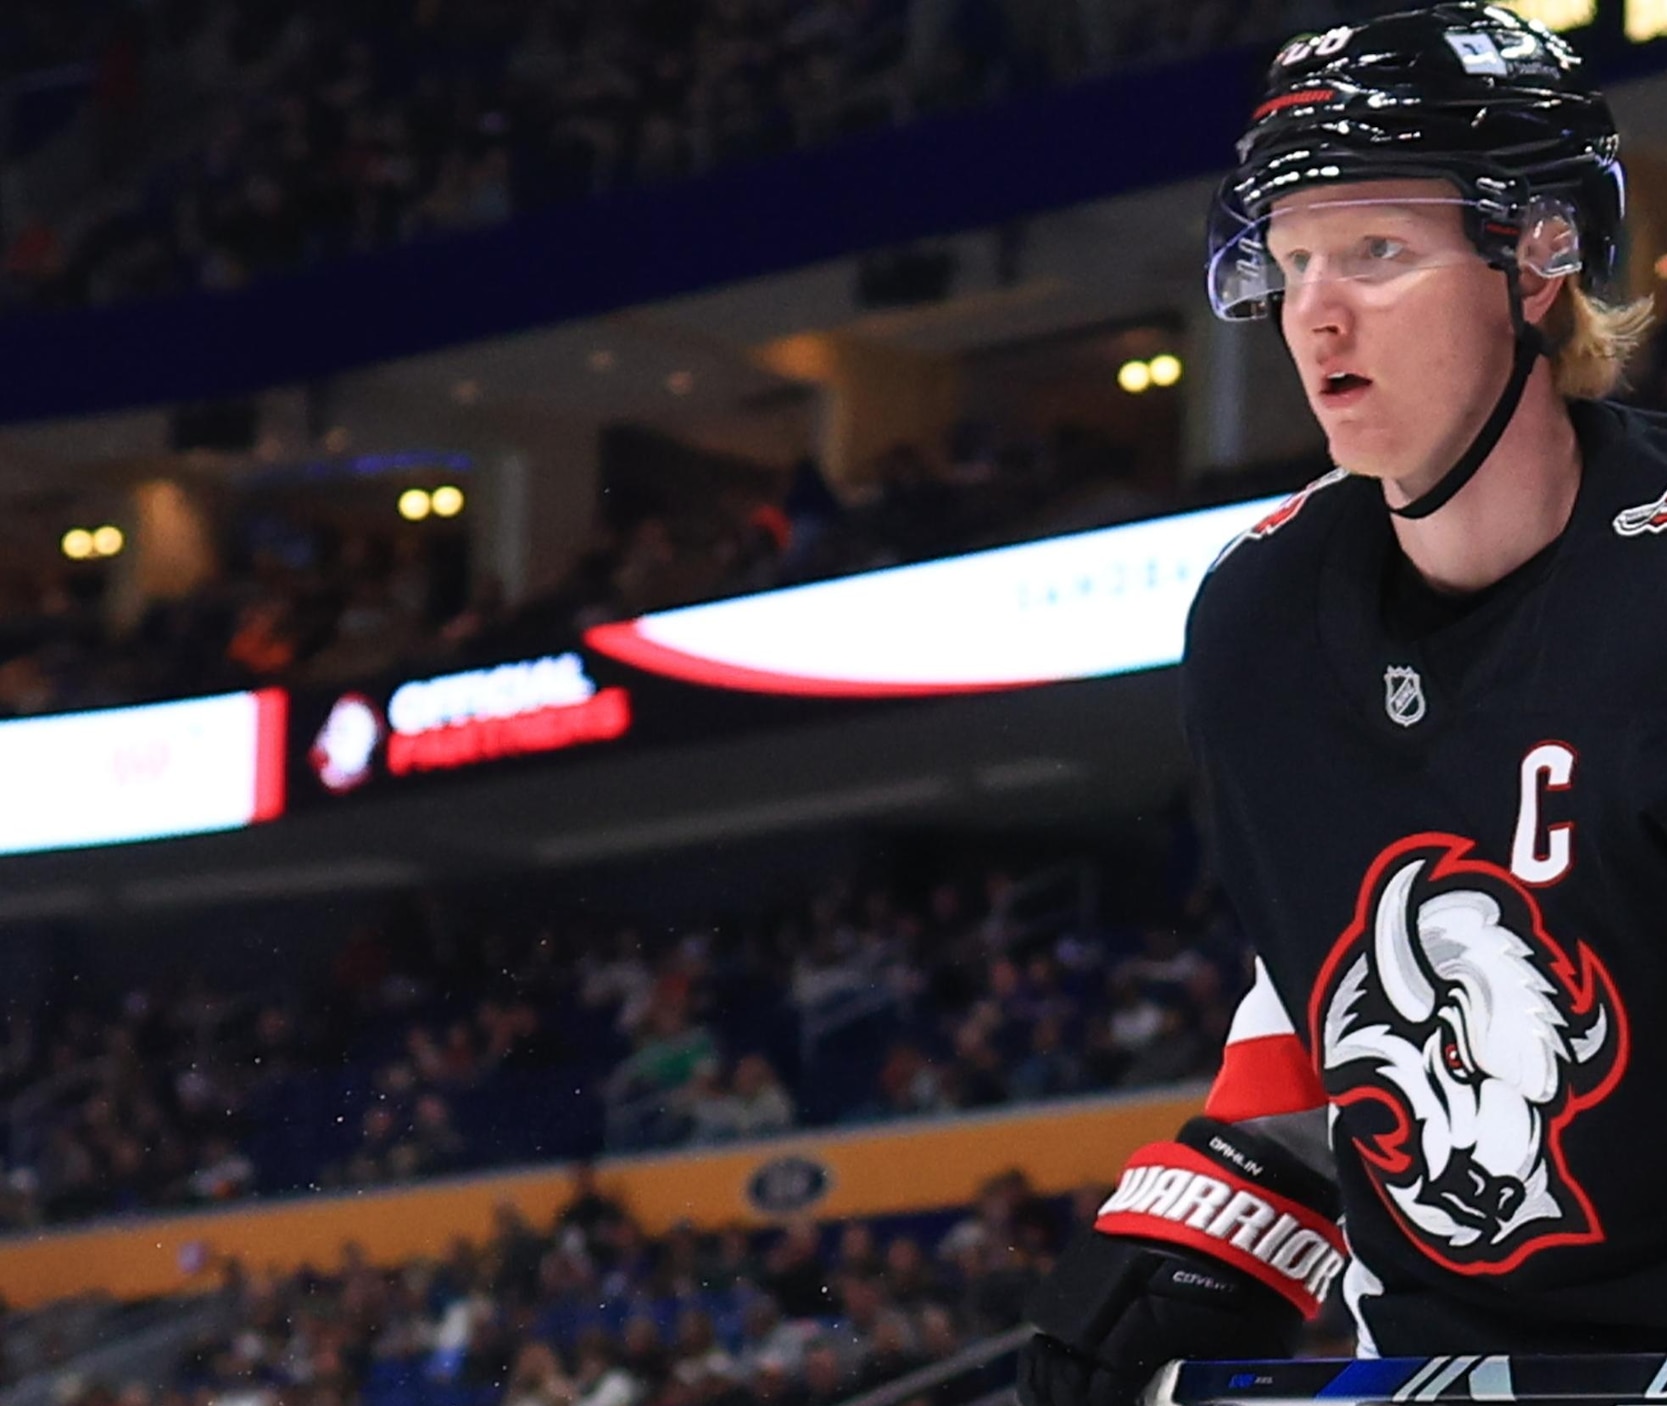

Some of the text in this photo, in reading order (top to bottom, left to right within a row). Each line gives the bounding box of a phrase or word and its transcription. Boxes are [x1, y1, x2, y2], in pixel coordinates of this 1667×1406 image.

[1510, 739, 1579, 887] C
[1208, 1135, 1263, 1177] DAHLIN
[1097, 1164, 1347, 1303] WARRIOR
